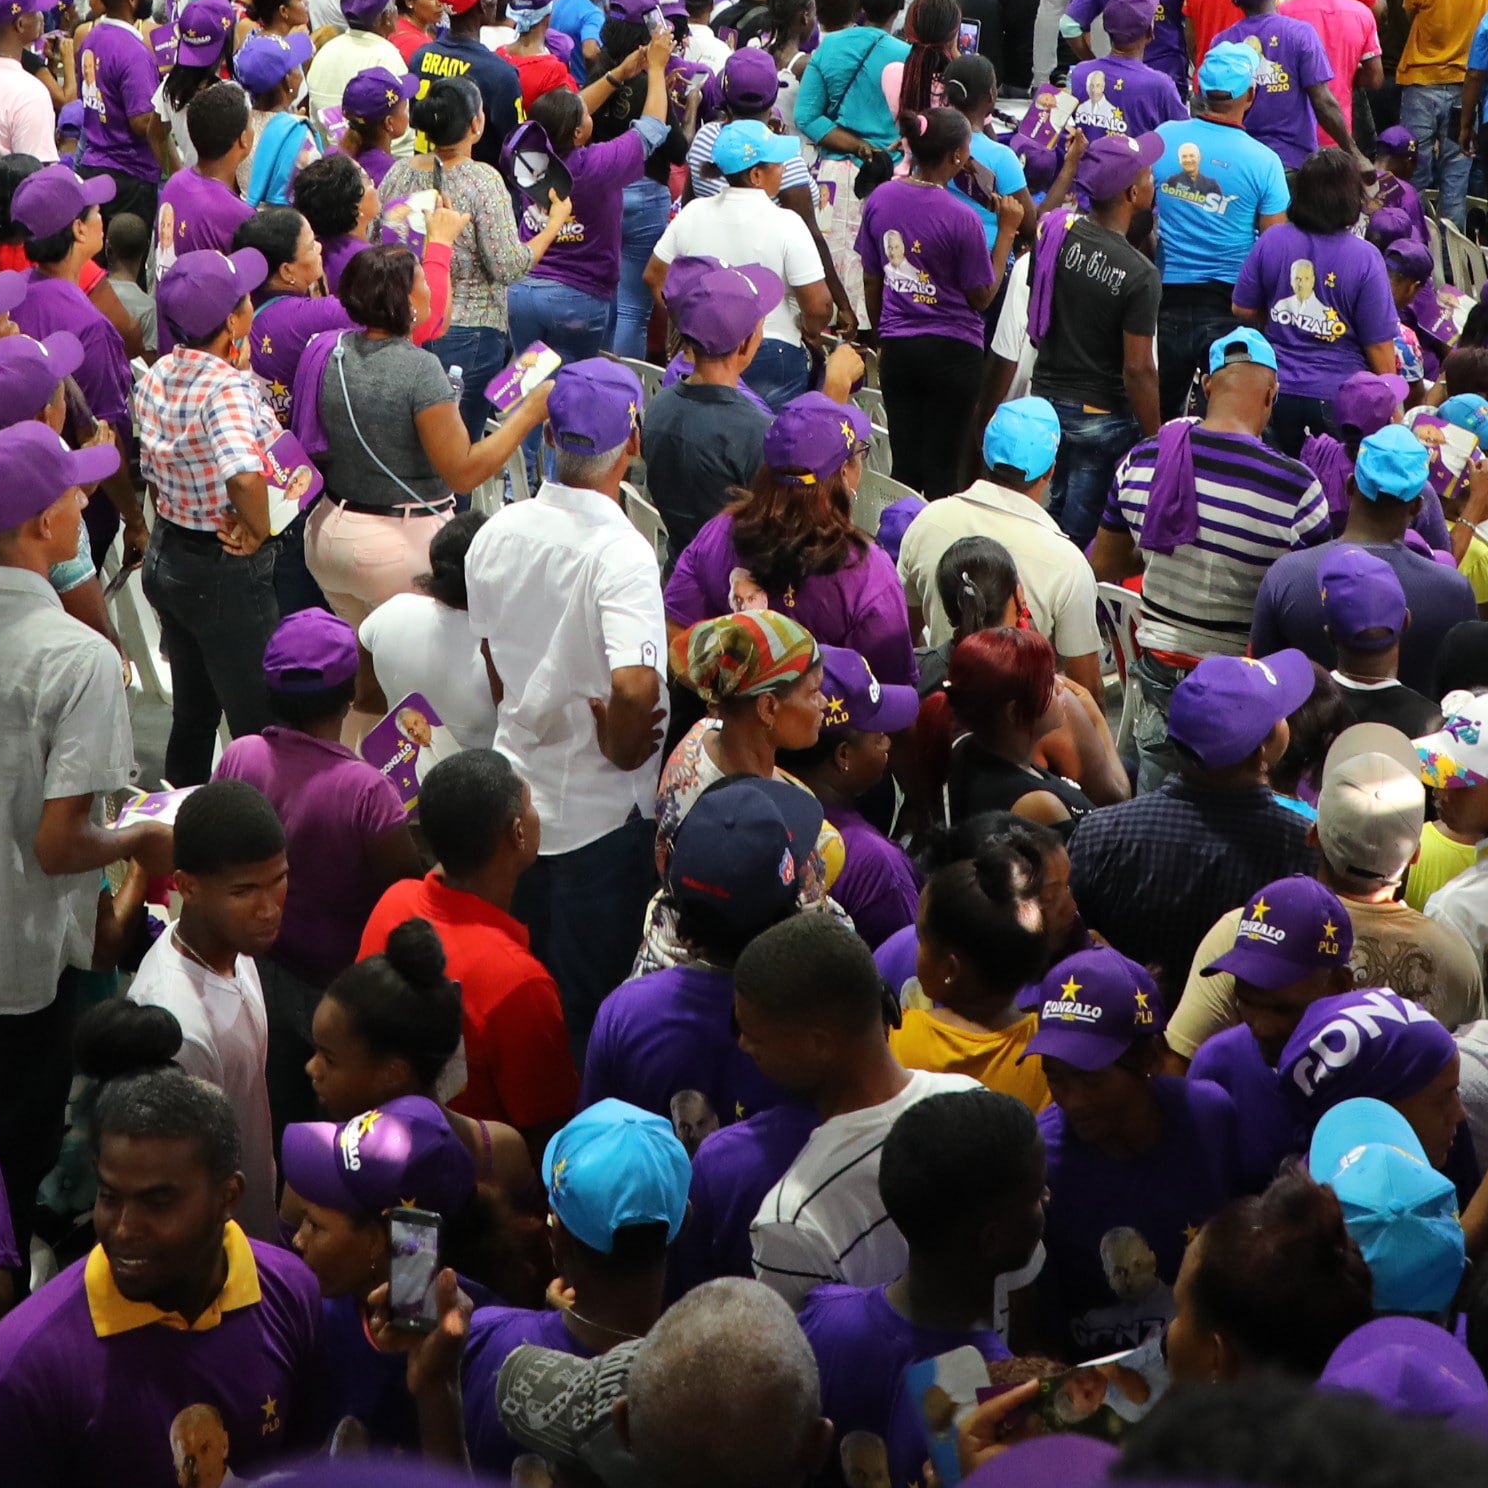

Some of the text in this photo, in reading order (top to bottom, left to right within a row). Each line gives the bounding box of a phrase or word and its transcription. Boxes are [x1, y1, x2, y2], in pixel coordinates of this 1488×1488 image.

[421, 52, 471, 77] BRADY
[1267, 83, 1290, 92] 2020
[1075, 111, 1127, 133] GONZALO
[1160, 183, 1206, 203] Gonzalo
[1087, 250, 1126, 296] Glory
[913, 293, 937, 304] 2020
[1270, 308, 1347, 337] GONZALO
[267, 452, 288, 483] GONZALO
[826, 711, 849, 727] PLD
[1318, 940, 1339, 955] PLD
[1041, 1000, 1103, 1020] GONZALO
[1134, 1012, 1153, 1025] PLD
[262, 1418, 281, 1436] PLD
